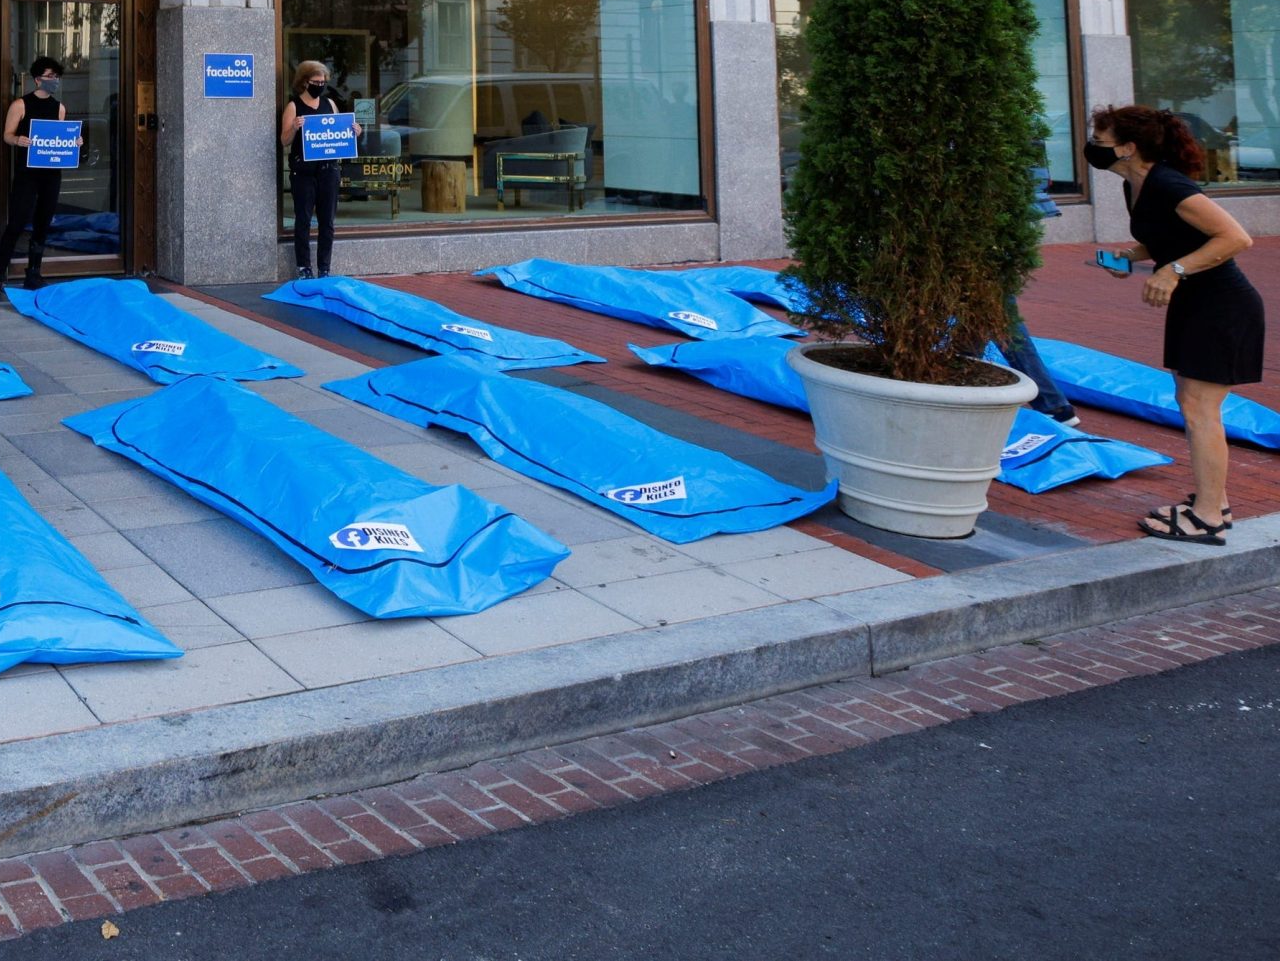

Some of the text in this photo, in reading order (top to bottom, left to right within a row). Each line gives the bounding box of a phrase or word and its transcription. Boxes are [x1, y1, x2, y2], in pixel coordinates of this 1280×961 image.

[206, 66, 251, 77] facebook
[305, 128, 354, 141] facebook
[32, 135, 78, 147] facebook
[363, 163, 413, 175] BEACON
[639, 480, 681, 494] DISINFO
[646, 489, 676, 501] KILLS
[362, 528, 410, 539] DISINFO
[374, 535, 409, 546] KILLS
